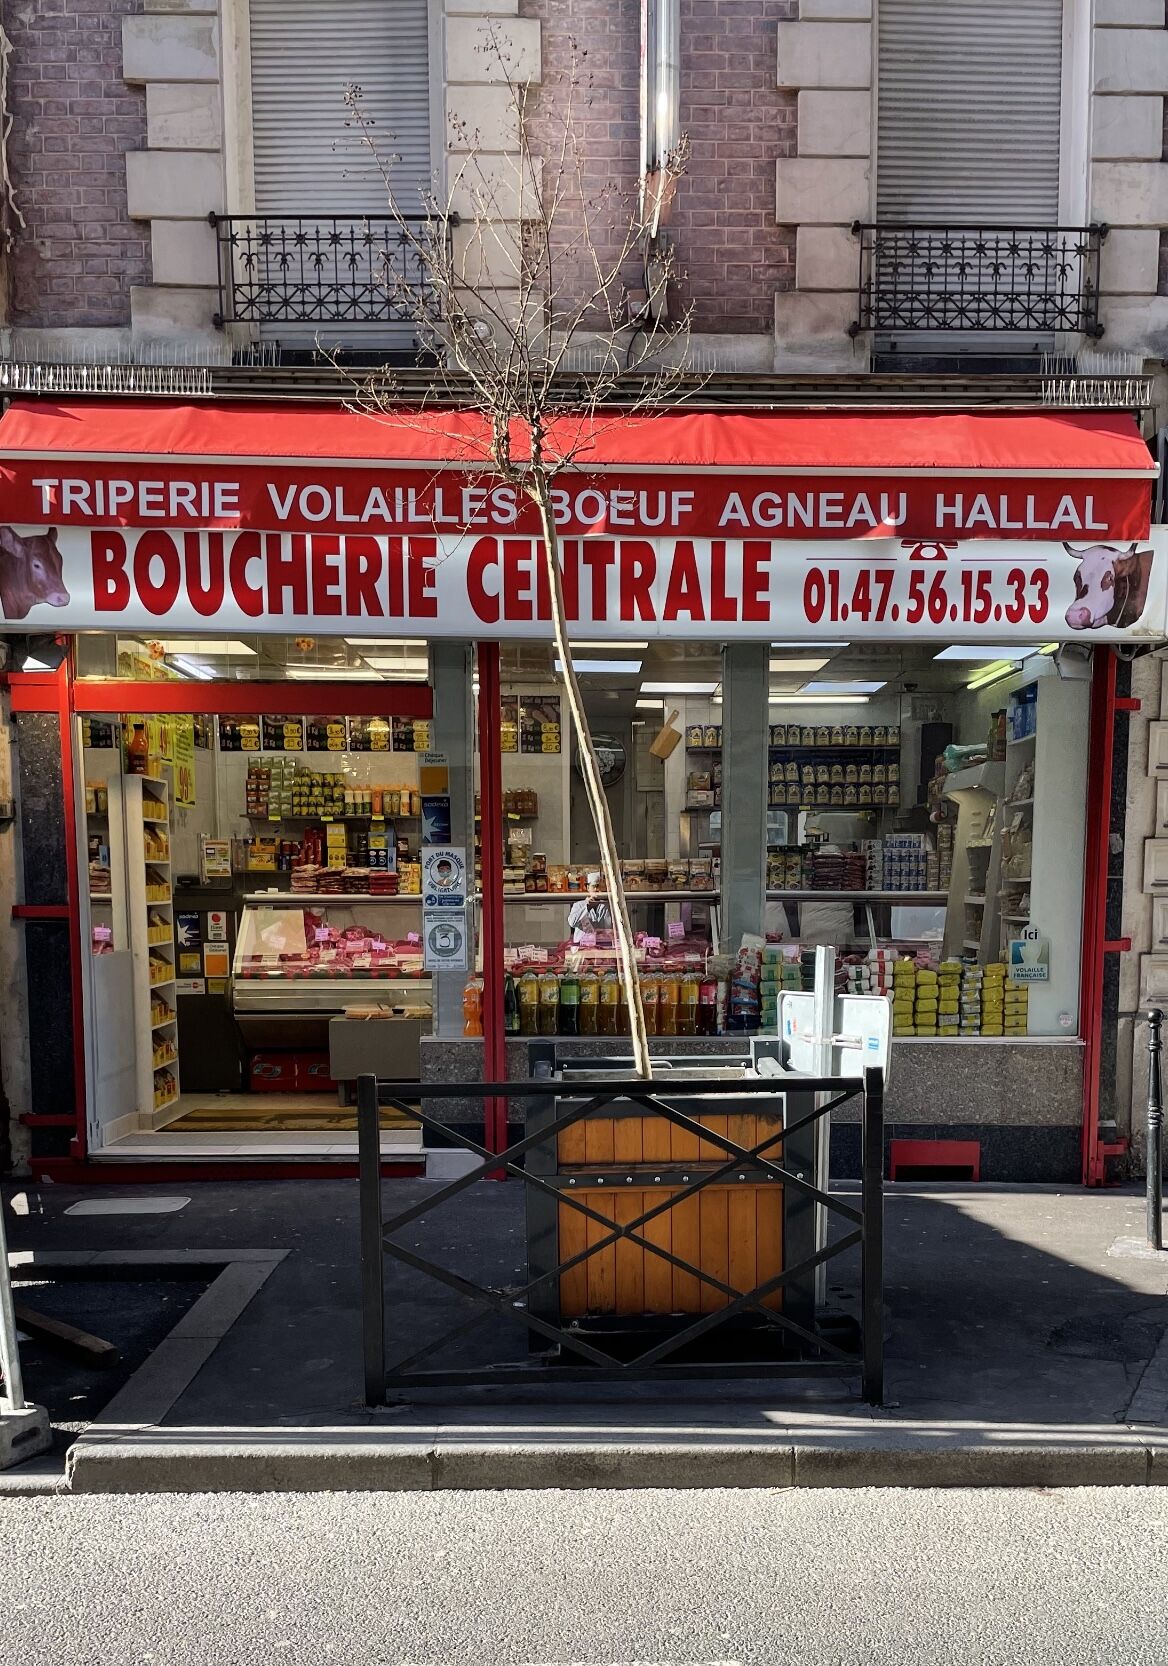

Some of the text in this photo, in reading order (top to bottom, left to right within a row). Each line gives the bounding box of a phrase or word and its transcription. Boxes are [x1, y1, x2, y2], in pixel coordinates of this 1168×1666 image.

[31, 478, 1109, 531] TRIPERIE VOLAILLES BOEUF AGNEAU HALLAL
[90, 529, 772, 624] BOUCHERIE CENTRALE
[803, 567, 1050, 624] 01.47.56.15.33
[424, 854, 436, 870] PORT
[445, 851, 465, 870] MASQUE
[1024, 928, 1038, 940] Ici
